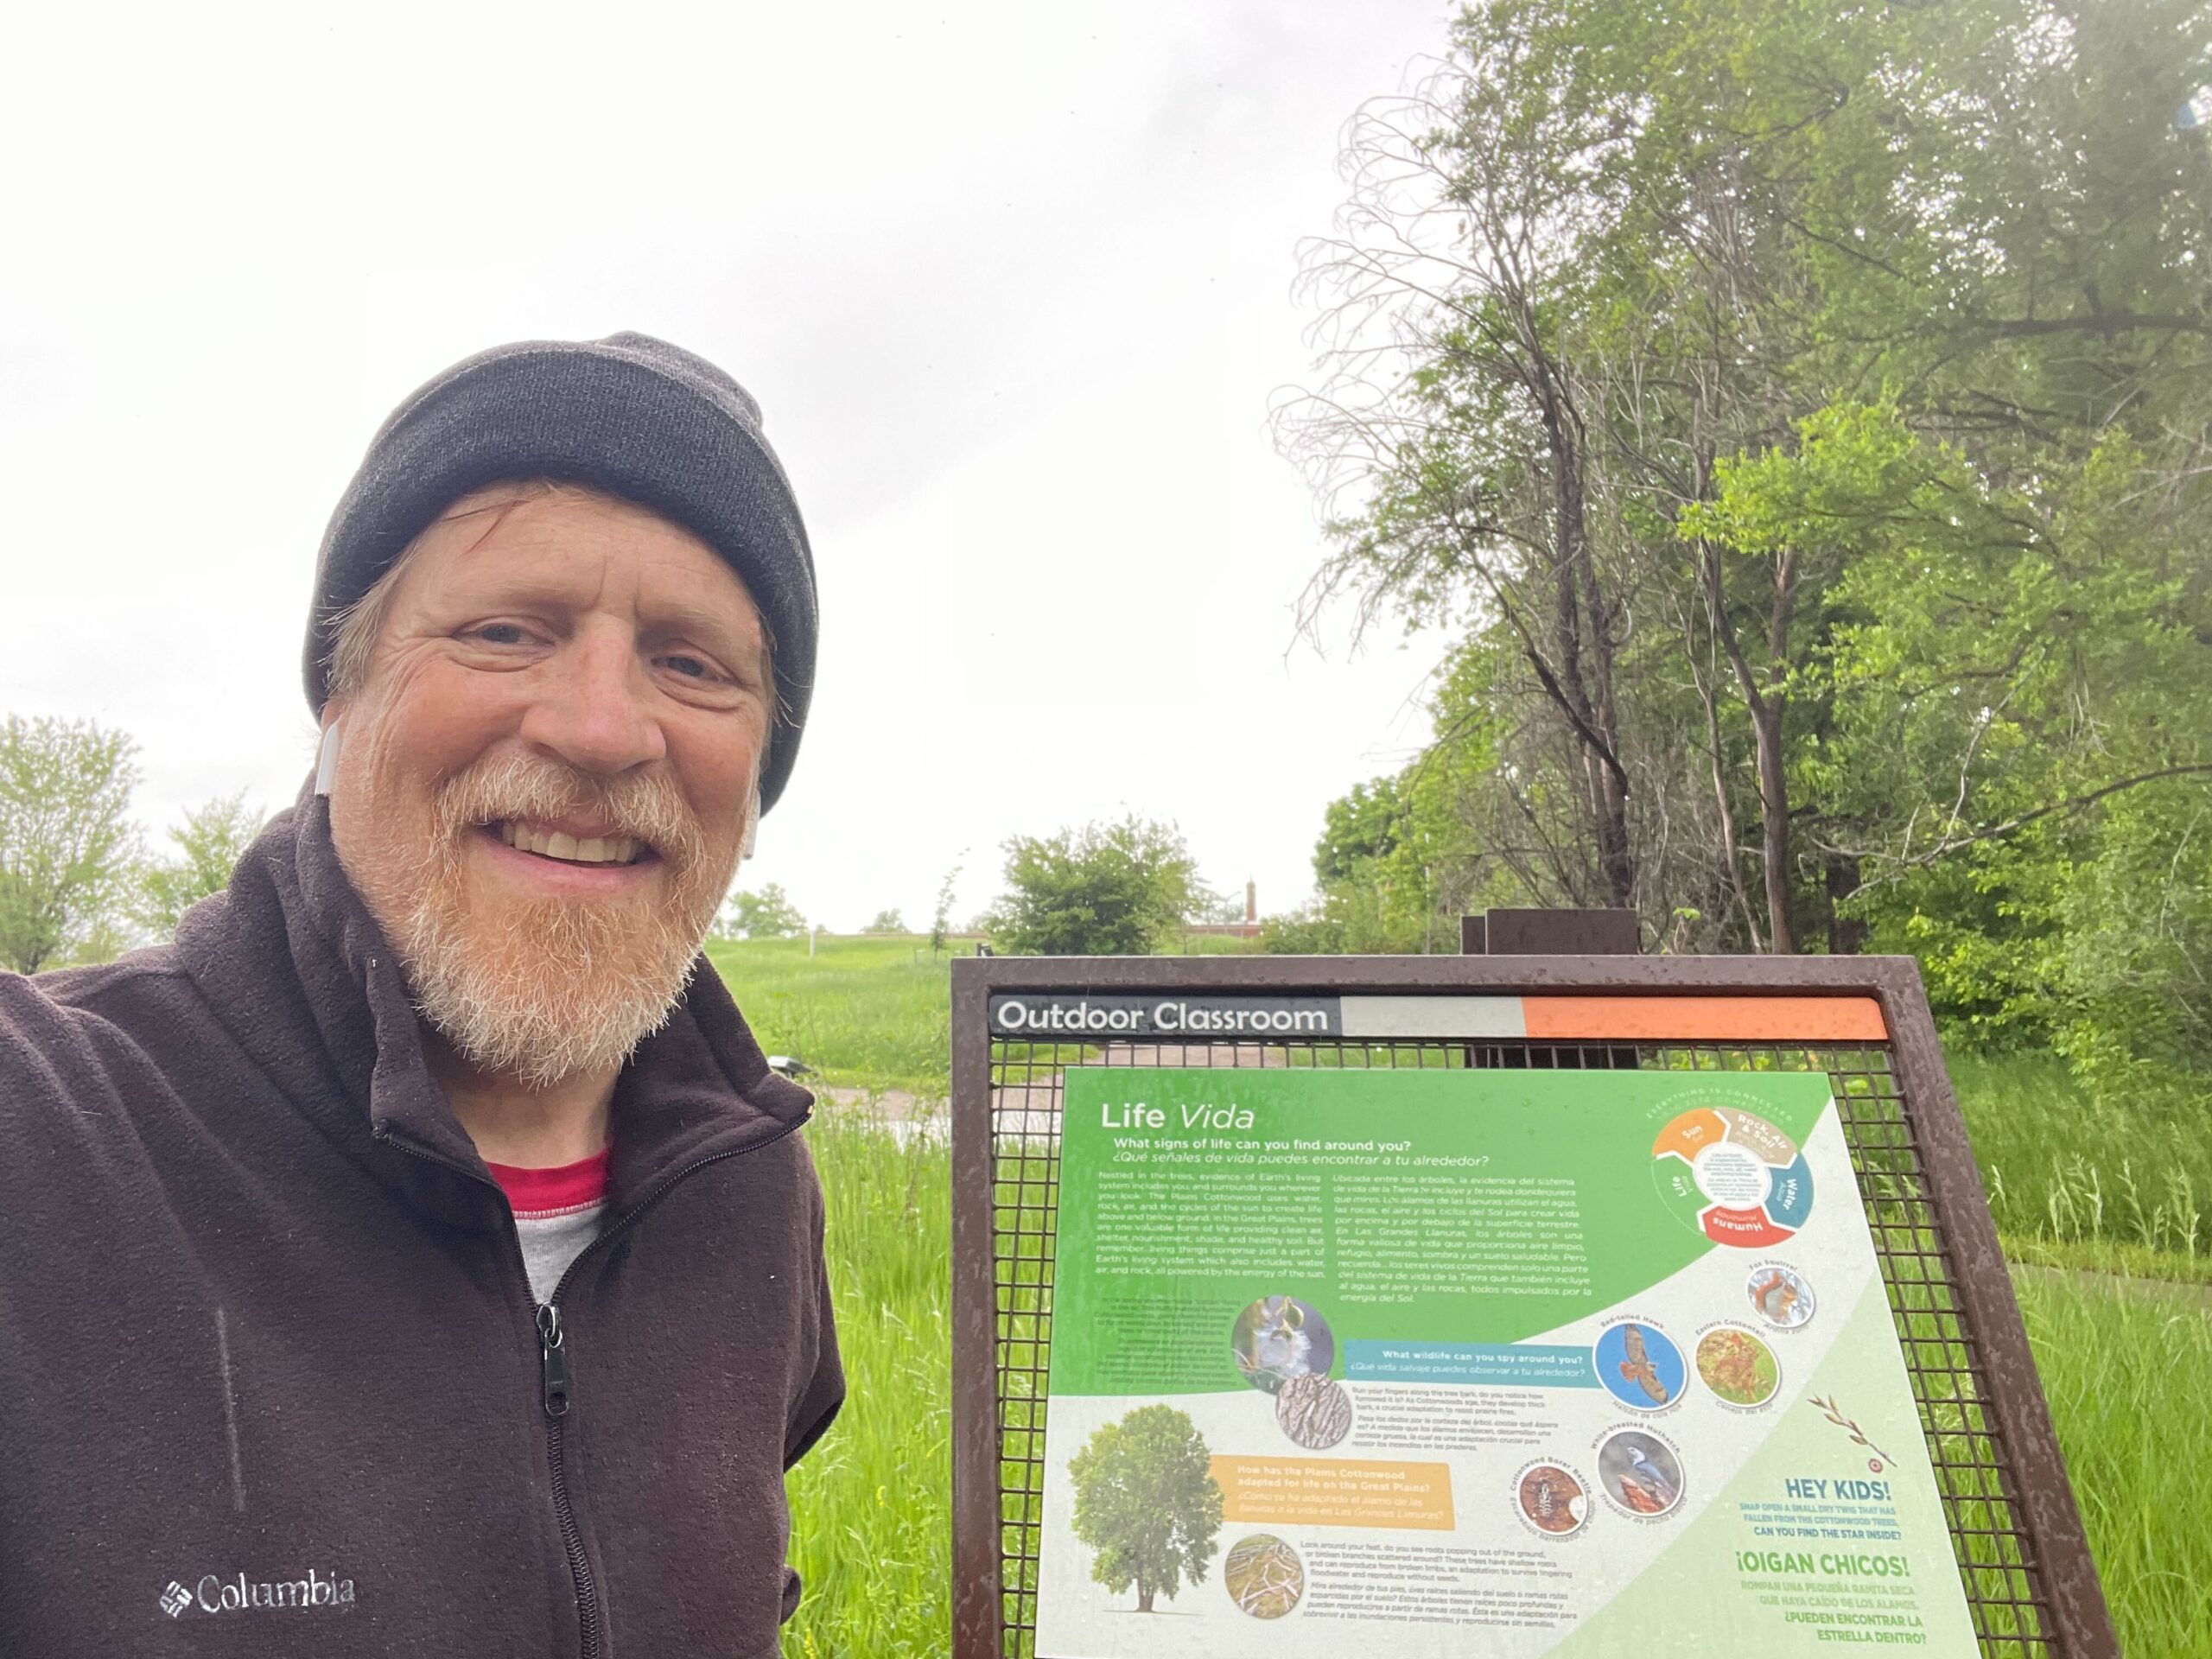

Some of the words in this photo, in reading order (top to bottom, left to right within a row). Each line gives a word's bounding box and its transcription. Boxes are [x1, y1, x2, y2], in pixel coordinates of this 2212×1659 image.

[997, 1001, 1144, 1030] Outdoor
[1154, 1002, 1328, 1031] Classroom
[1102, 1103, 1165, 1128] Life
[1181, 1103, 1254, 1128] Vida
[1682, 1125, 1703, 1139] Sun
[1742, 1124, 1750, 1132] &
[1754, 1130, 1775, 1148] Soil
[1114, 1138, 1149, 1148] What
[1154, 1139, 1188, 1152] signs
[1192, 1138, 1206, 1149] of
[1210, 1139, 1231, 1149] life
[1236, 1141, 1259, 1150] can
[1264, 1141, 1289, 1153] you
[1293, 1140, 1320, 1150] find
[1324, 1140, 1373, 1151] around
[1377, 1140, 1411, 1154] you?
[1772, 1134, 1788, 1149] Air
[1112, 1151, 1147, 1164] ¿Qué
[1151, 1151, 1200, 1163] señales
[1205, 1152, 1222, 1163] de
[1226, 1152, 1254, 1163] vida
[1257, 1152, 1307, 1166] puedes
[1312, 1153, 1378, 1165] encontrar
[1395, 1154, 1409, 1165] tu
[1413, 1154, 1489, 1166] alrededor?
[1332, 1174, 1370, 1183] Ubicada
[1401, 1175, 1415, 1183] los
[1470, 1176, 1515, 1185] evidencia
[1672, 1176, 1687, 1197] Life
[1783, 1178, 1798, 1211] Water
[1713, 1217, 1763, 1231] Humans
[1335, 1227, 1348, 1235] En
[1354, 1227, 1372, 1236] Las
[1378, 1228, 1418, 1236] Grandes
[1475, 1229, 1489, 1238] los
[1496, 1230, 1532, 1239] árboles
[1336, 1237, 1364, 1246] forma
[1368, 1238, 1401, 1247] valiosa
[1404, 1239, 1416, 1247] de
[1420, 1239, 1441, 1248] vida
[1466, 1240, 1526, 1251] proporciona
[1529, 1242, 1548, 1250] aire
[1749, 1262, 1763, 1271] Fox
[1765, 1259, 1797, 1271] Squirrel
[1339, 1293, 1376, 1303] energía
[1378, 1294, 1394, 1302] del
[1601, 1315, 1640, 1327] Red-tailed
[1643, 1316, 1664, 1329] Hawk
[1695, 1320, 1722, 1336] Eastern
[1724, 1319, 1766, 1338] Cottontail
[1382, 1350, 1409, 1359] What
[1413, 1351, 1450, 1360] wildlife
[1475, 1354, 1494, 1364] you
[1497, 1355, 1514, 1365] spy
[1518, 1354, 1555, 1363] around
[1558, 1355, 1583, 1367] you?
[1591, 1422, 1643, 1449] White-breasted
[1646, 1425, 1681, 1453] Nuthatch
[1237, 1465, 1259, 1475] How
[1263, 1466, 1281, 1475] has
[1284, 1467, 1301, 1476] the
[1304, 1468, 1336, 1477] Plains
[1339, 1469, 1405, 1480] Cottonwood
[1511, 1457, 1545, 1491] Cottonwood
[1548, 1457, 1571, 1469] Borer
[1573, 1468, 1592, 1494] Beetle
[1237, 1477, 1281, 1489] adapted
[1284, 1479, 1299, 1488] for
[1302, 1479, 1319, 1489] life
[1339, 1481, 1356, 1490] the
[1360, 1481, 1389, 1491] Great
[1393, 1482, 1430, 1492] Plains?
[1786, 1478, 1827, 1499] HEY
[1834, 1480, 1891, 1500] KIDS!
[1754, 1527, 1773, 1536] CAN
[1776, 1527, 1794, 1537] YOU
[1797, 1528, 1818, 1538] FIND
[1821, 1529, 1838, 1538] THE
[1841, 1530, 1864, 1539] STAR
[1866, 1530, 1902, 1540] INSIDE?
[1736, 1551, 1815, 1573] ¡OIGAN
[1820, 1554, 1910, 1577] CHICOS!
[196, 1568, 356, 1613] Columbia
[1785, 1612, 1834, 1623] ¿PUEDEN
[1837, 1614, 1905, 1626] ENCONTRAR
[1908, 1616, 1923, 1627] LA
[1817, 1630, 1873, 1642] ESTRELLA
[1875, 1631, 1926, 1644] DENTRO?
